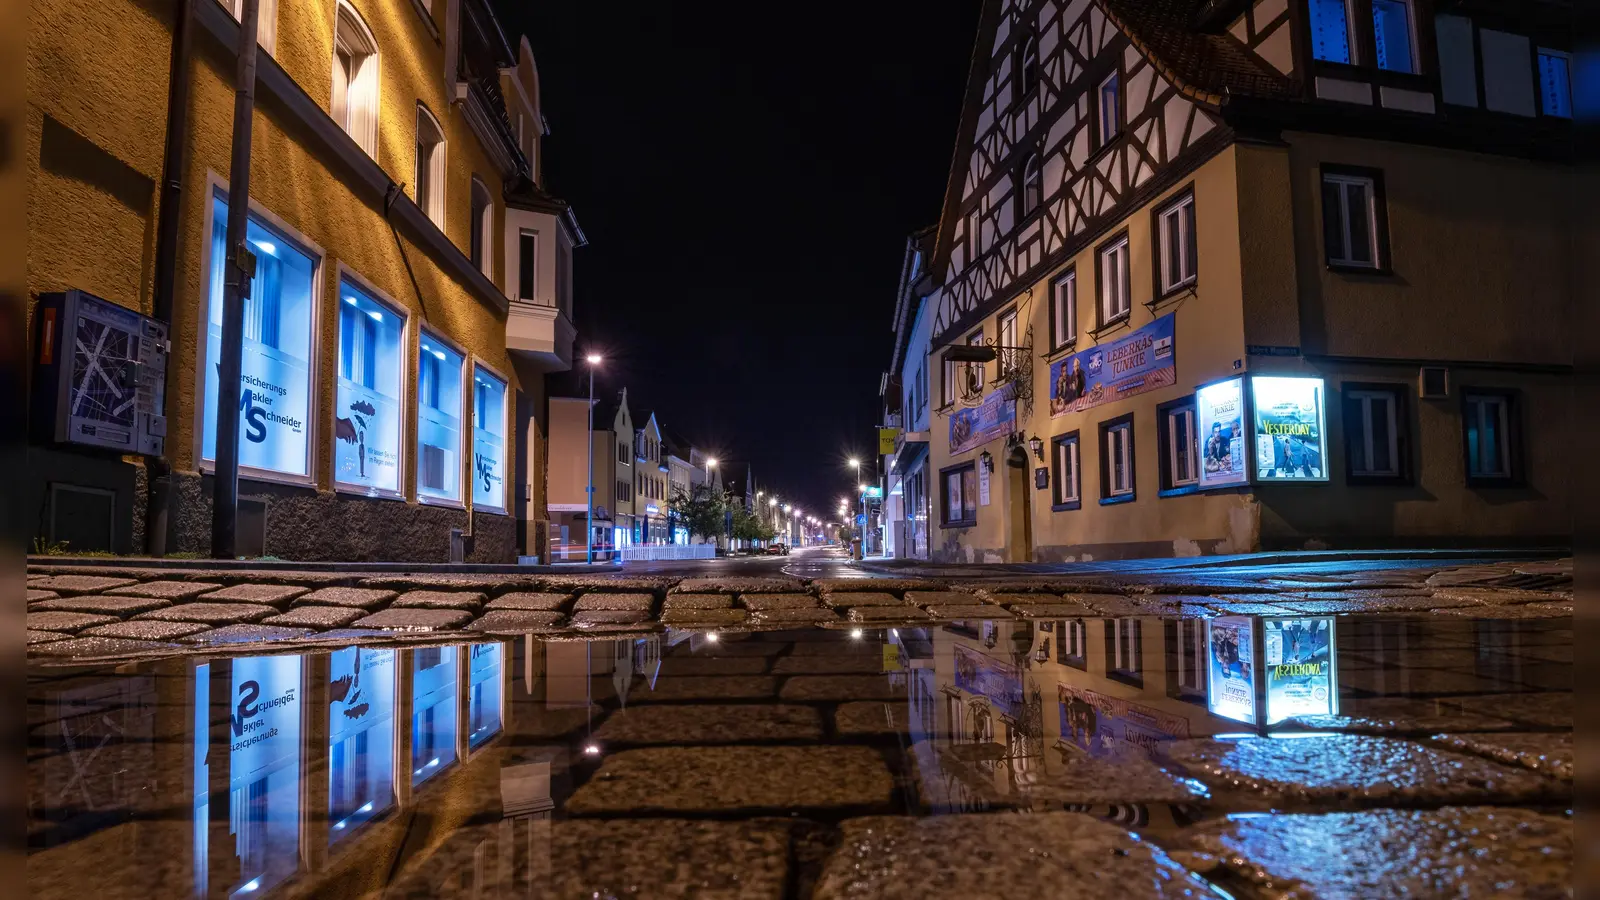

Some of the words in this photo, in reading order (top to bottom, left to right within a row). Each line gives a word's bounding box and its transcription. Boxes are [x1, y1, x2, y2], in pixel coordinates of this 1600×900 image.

[1112, 351, 1146, 378] JUNKIE
[239, 374, 287, 396] rsicherungs
[1263, 420, 1310, 436] YESTERDAY
